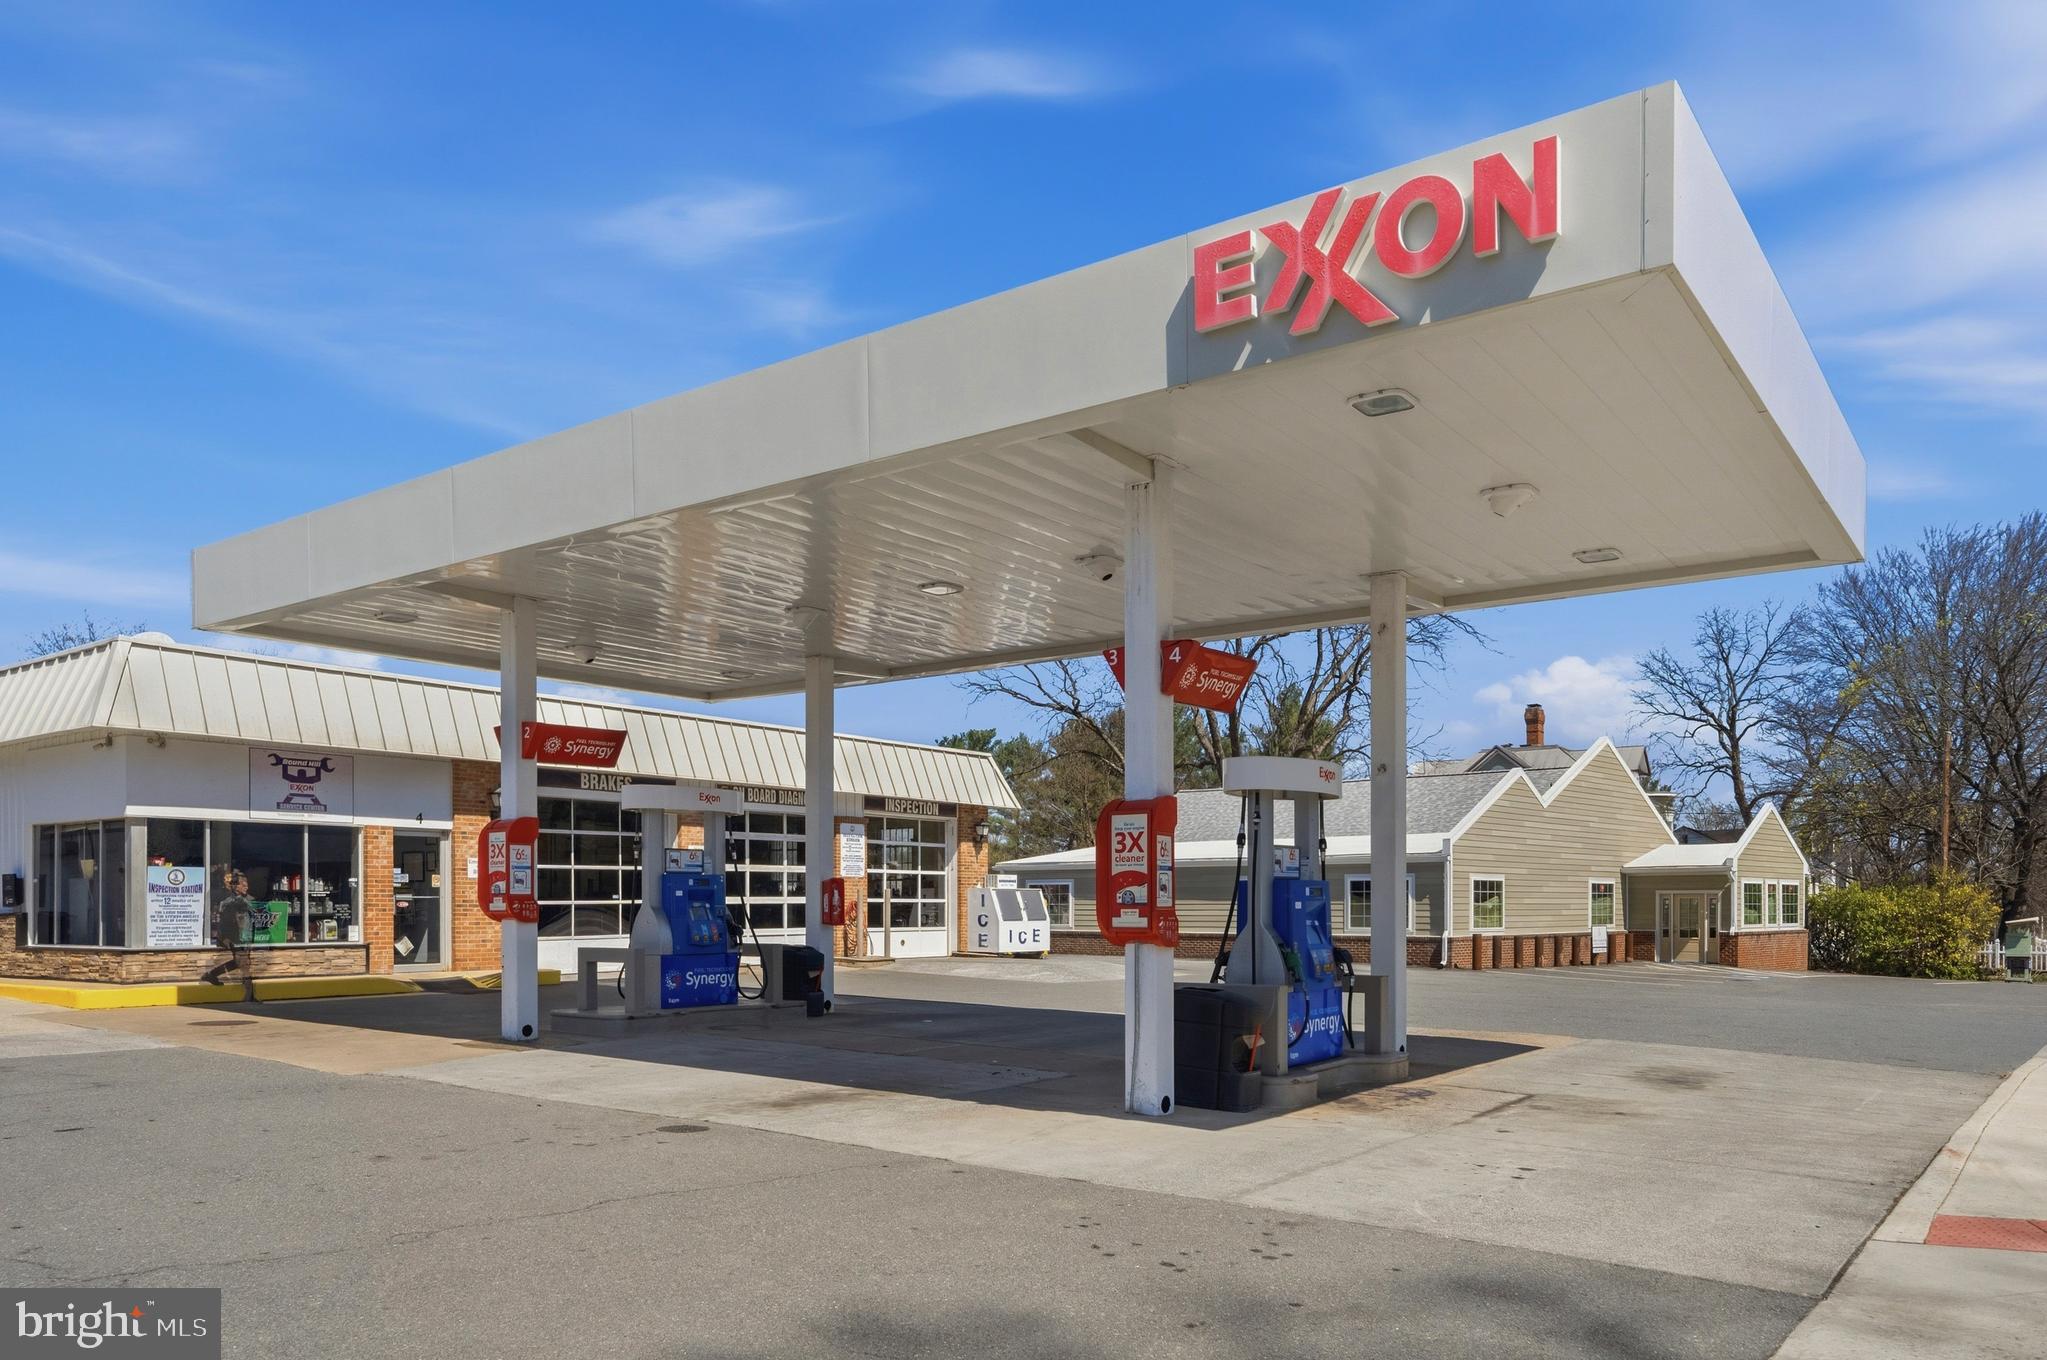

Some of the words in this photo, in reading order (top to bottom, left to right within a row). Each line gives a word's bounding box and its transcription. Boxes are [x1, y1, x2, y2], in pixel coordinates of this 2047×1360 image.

[1194, 135, 1561, 336] EXXON
[1108, 650, 1118, 666] 3
[1169, 646, 1182, 663] 4
[1196, 671, 1240, 699] Synergy
[524, 727, 530, 739] 2
[564, 741, 614, 759] Synergy
[1319, 766, 1336, 783] Exxon
[290, 783, 315, 793] EXXON
[747, 787, 776, 804] BOARD
[779, 790, 806, 806] DIAGN
[699, 792, 721, 805] Exxon
[885, 798, 939, 816] INSPECTION
[416, 812, 424, 824] 4
[490, 843, 505, 859] 3X
[1115, 831, 1145, 854] 3X
[1115, 855, 1145, 863] cleaner
[149, 882, 180, 894] INSPECTION
[181, 883, 203, 894] STATION
[164, 897, 171, 905] 12
[977, 894, 989, 948] ICE
[1009, 928, 1041, 945] ICE
[686, 971, 735, 990] Synergy
